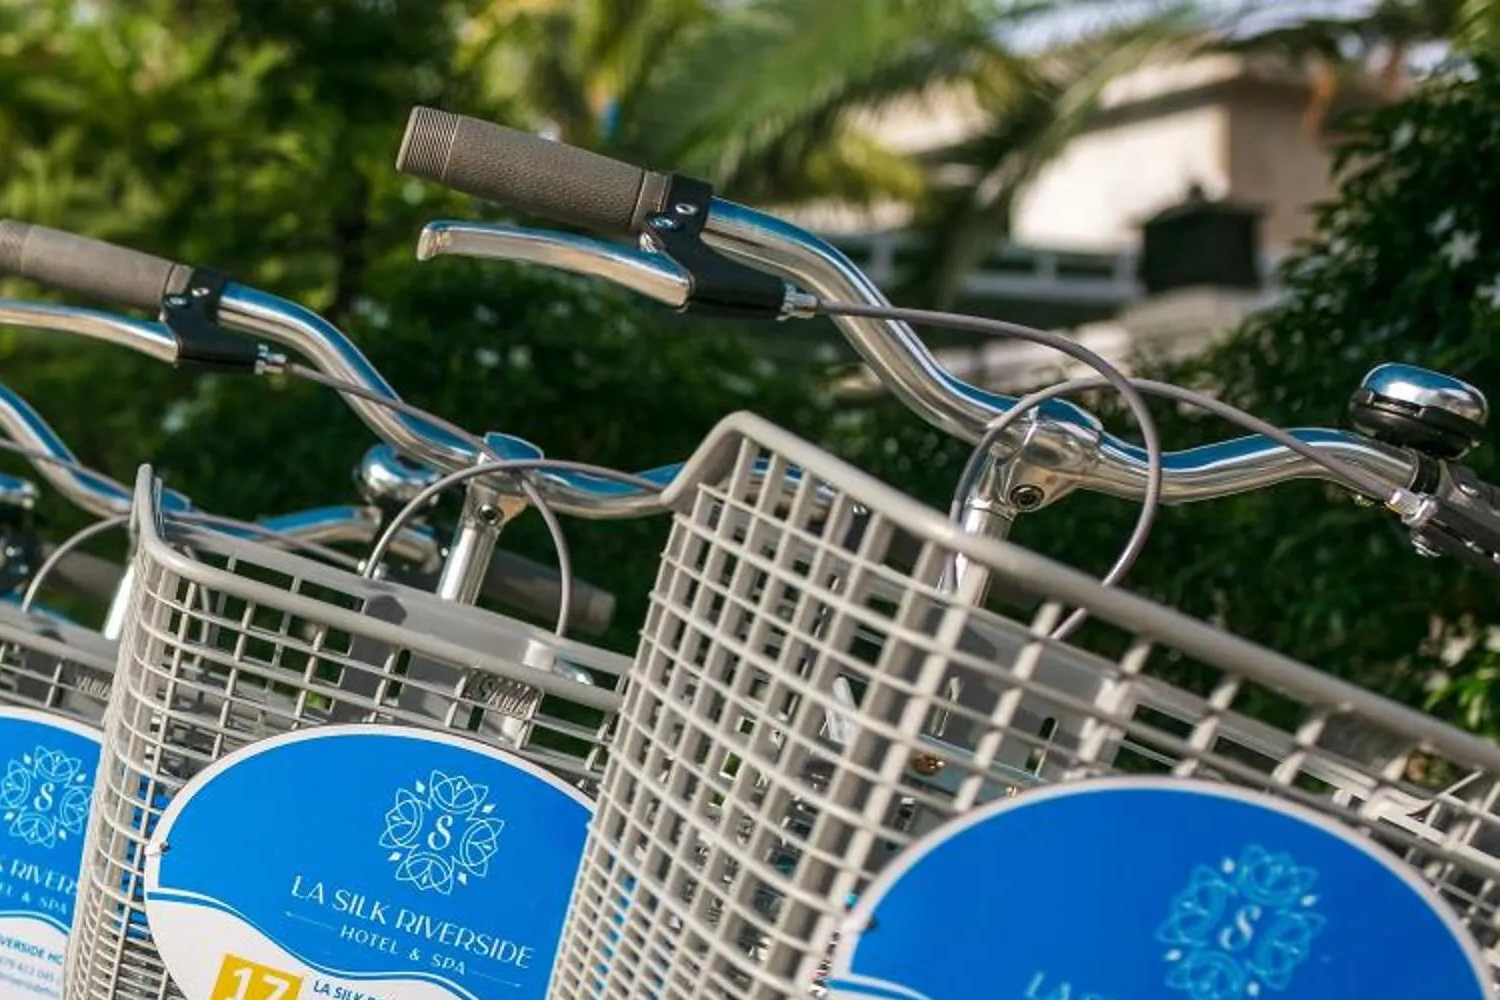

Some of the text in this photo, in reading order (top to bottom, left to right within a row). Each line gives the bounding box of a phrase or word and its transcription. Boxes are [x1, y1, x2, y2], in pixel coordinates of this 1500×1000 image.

[428, 814, 453, 850] S
[291, 875, 537, 969] LA SILK RIVERSIDE
[339, 924, 466, 975] HOTEL & SPA
[313, 979, 331, 998] LA
